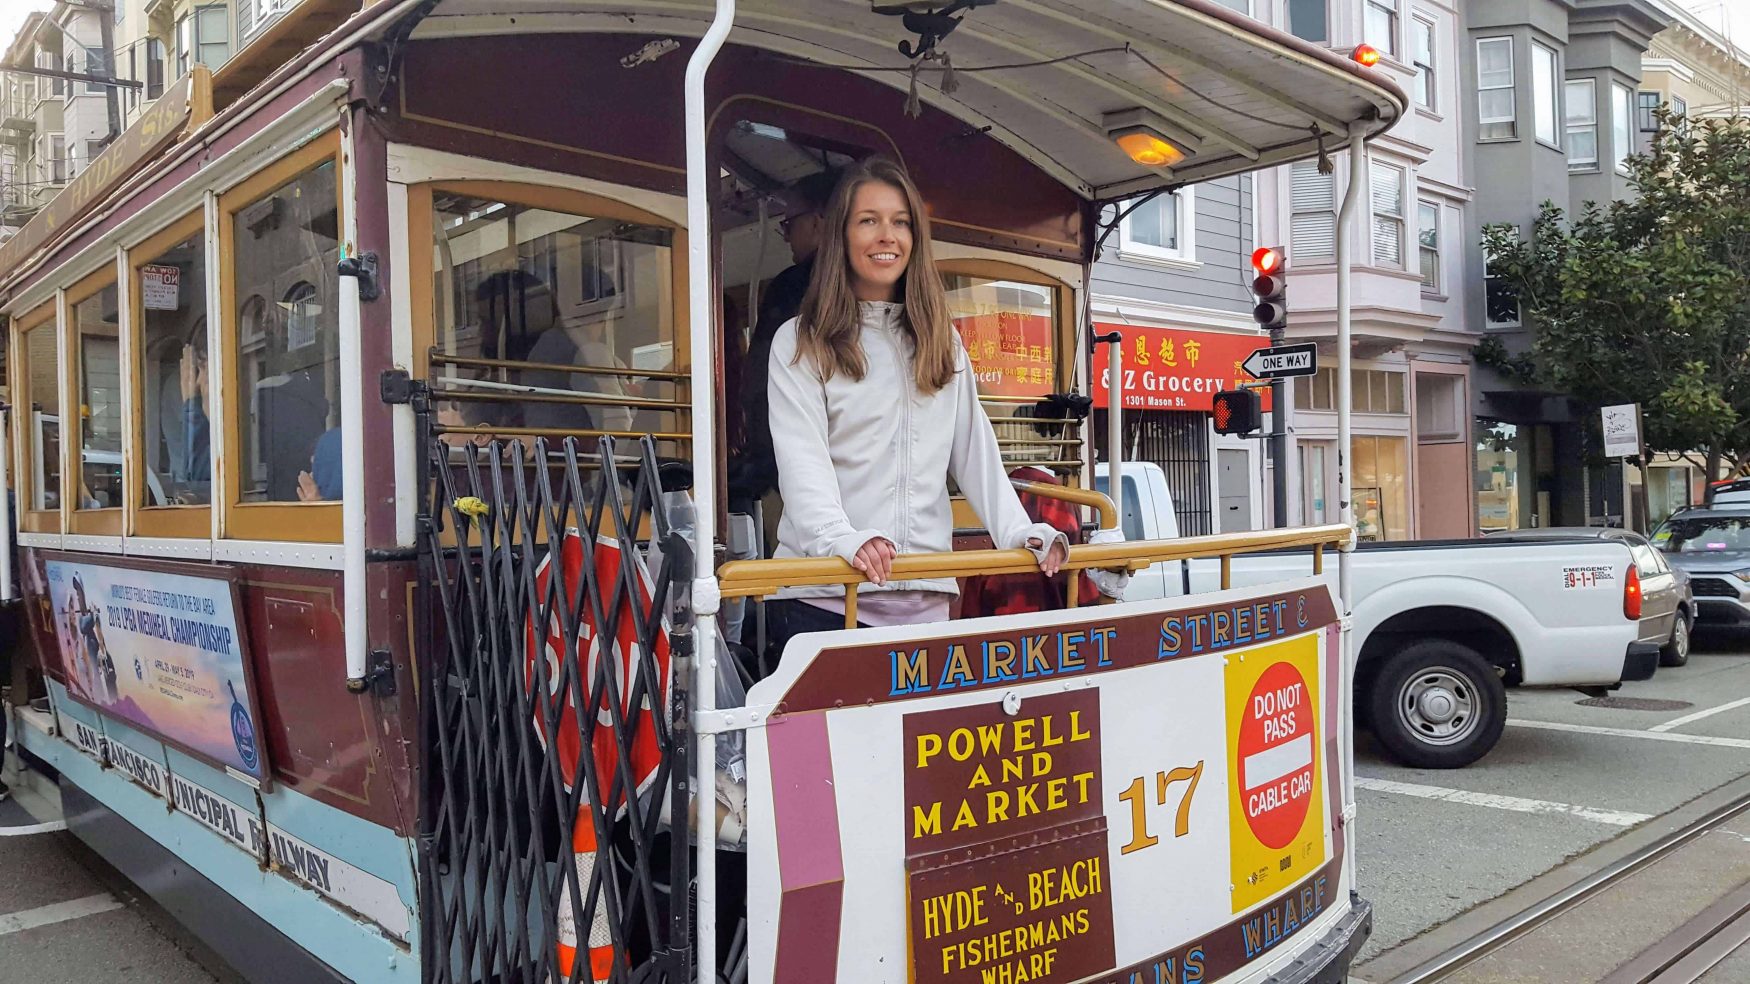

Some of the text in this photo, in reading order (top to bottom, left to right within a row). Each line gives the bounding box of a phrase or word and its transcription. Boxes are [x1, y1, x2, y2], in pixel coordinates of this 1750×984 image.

[70, 139, 128, 210] HYDE
[1107, 335, 1201, 368] 恩超市
[1262, 356, 1283, 370] ONE
[1286, 352, 1309, 368] WAY
[1124, 370, 1136, 390] Z
[1142, 370, 1224, 392] Grocery
[1125, 395, 1187, 407] 1301 Mason St.
[1569, 571, 1596, 588] 9-1-1
[107, 605, 232, 656] 2019 LPGA MEDIHEAL CHAMPIONSHIP
[888, 626, 1117, 697] MARKET
[1157, 600, 1288, 660] STREET
[1254, 683, 1302, 720] DO NOT
[916, 710, 1091, 769] POWELL
[1264, 711, 1296, 744] PASS
[968, 751, 1053, 790] AND
[1248, 770, 1312, 818] CABLE CAR
[76, 723, 99, 753] SAN
[162, 771, 245, 843] UNICIPAL
[248, 818, 331, 893] RILWAY
[913, 771, 1095, 839] MARKET
[1118, 759, 1204, 856] 17
[923, 856, 1102, 940] HYDE AND BEACH
[1242, 874, 1328, 959] WHARF
[942, 908, 1090, 975] FISHERMANS
[981, 948, 1057, 984] WHARF
